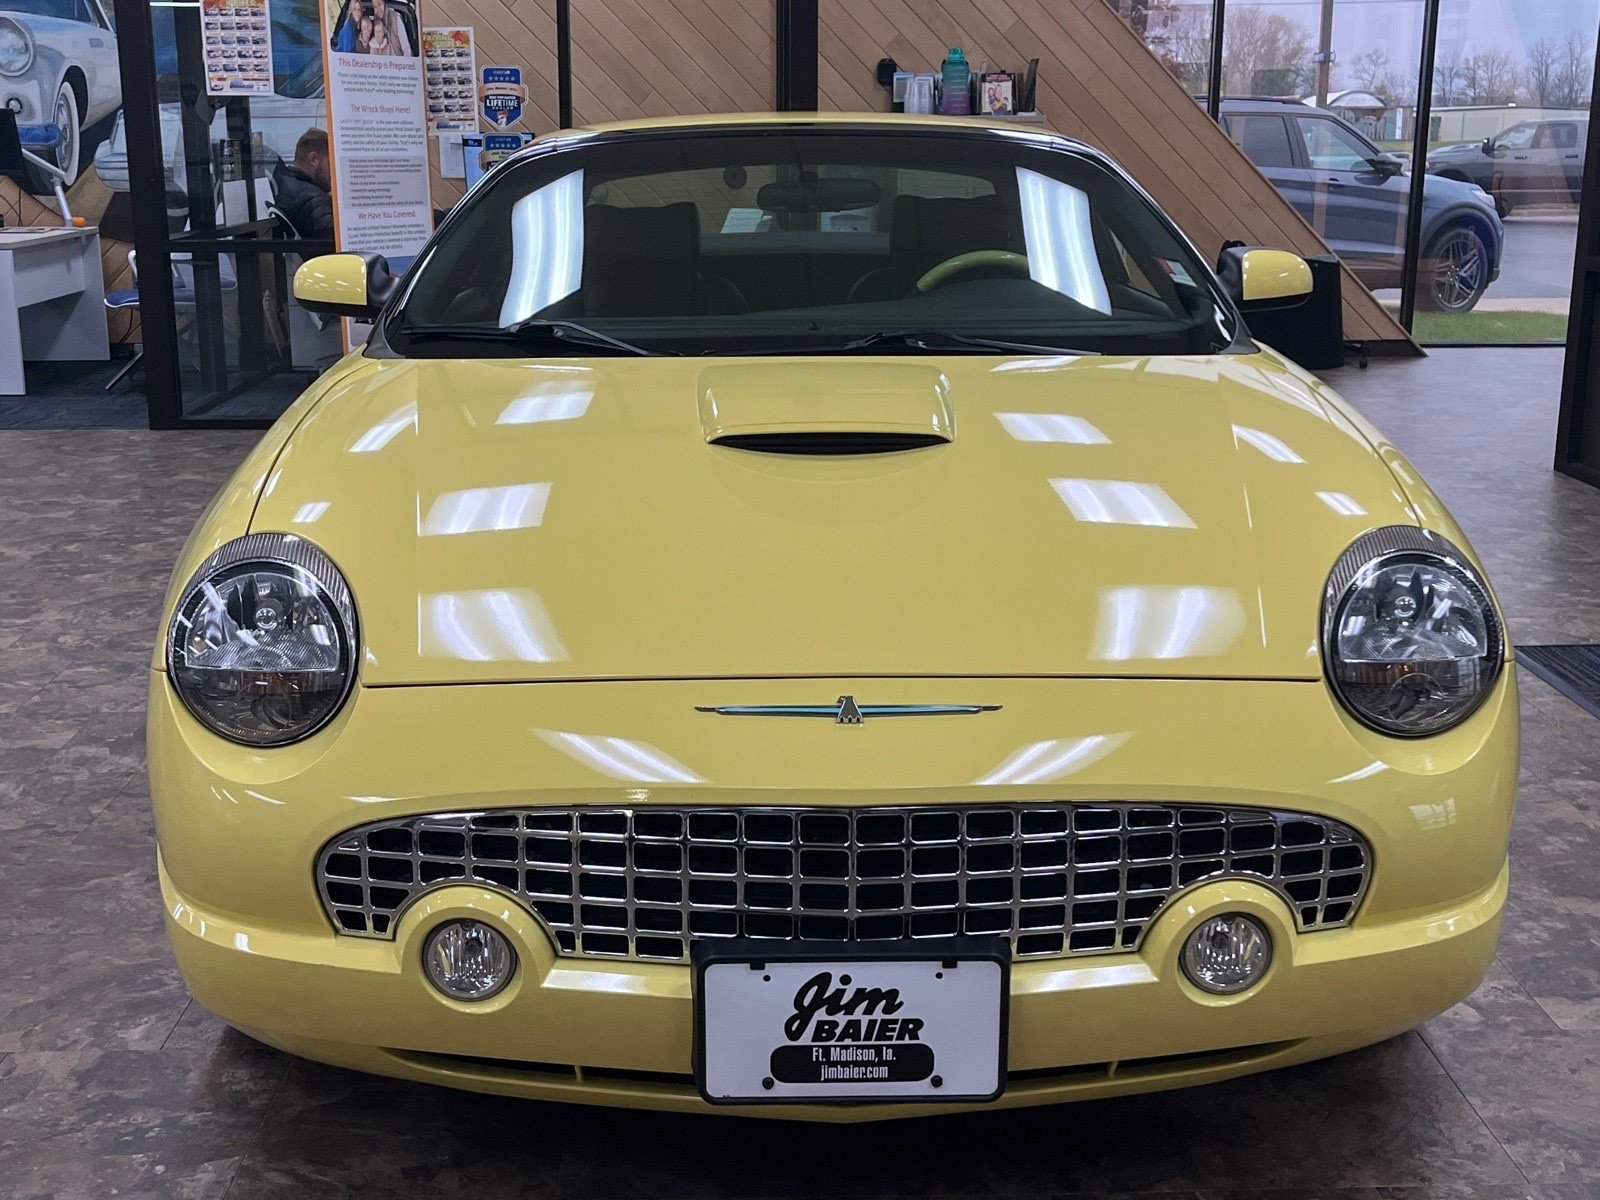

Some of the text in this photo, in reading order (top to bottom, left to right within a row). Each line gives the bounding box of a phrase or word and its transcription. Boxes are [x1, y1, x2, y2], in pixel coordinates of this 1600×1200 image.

[339, 58, 351, 66] This
[352, 59, 382, 70] Dealership
[389, 62, 416, 71] Prepared.
[351, 104, 360, 112] The
[379, 105, 394, 114] Stops
[486, 99, 518, 107] LIFETIME
[382, 211, 392, 219] You
[784, 971, 904, 1042] Jim
[811, 1018, 924, 1042] BAIER
[812, 1047, 826, 1062] Ft.
[830, 1046, 879, 1063] Madison,
[820, 1065, 888, 1081] jimbaier.com
